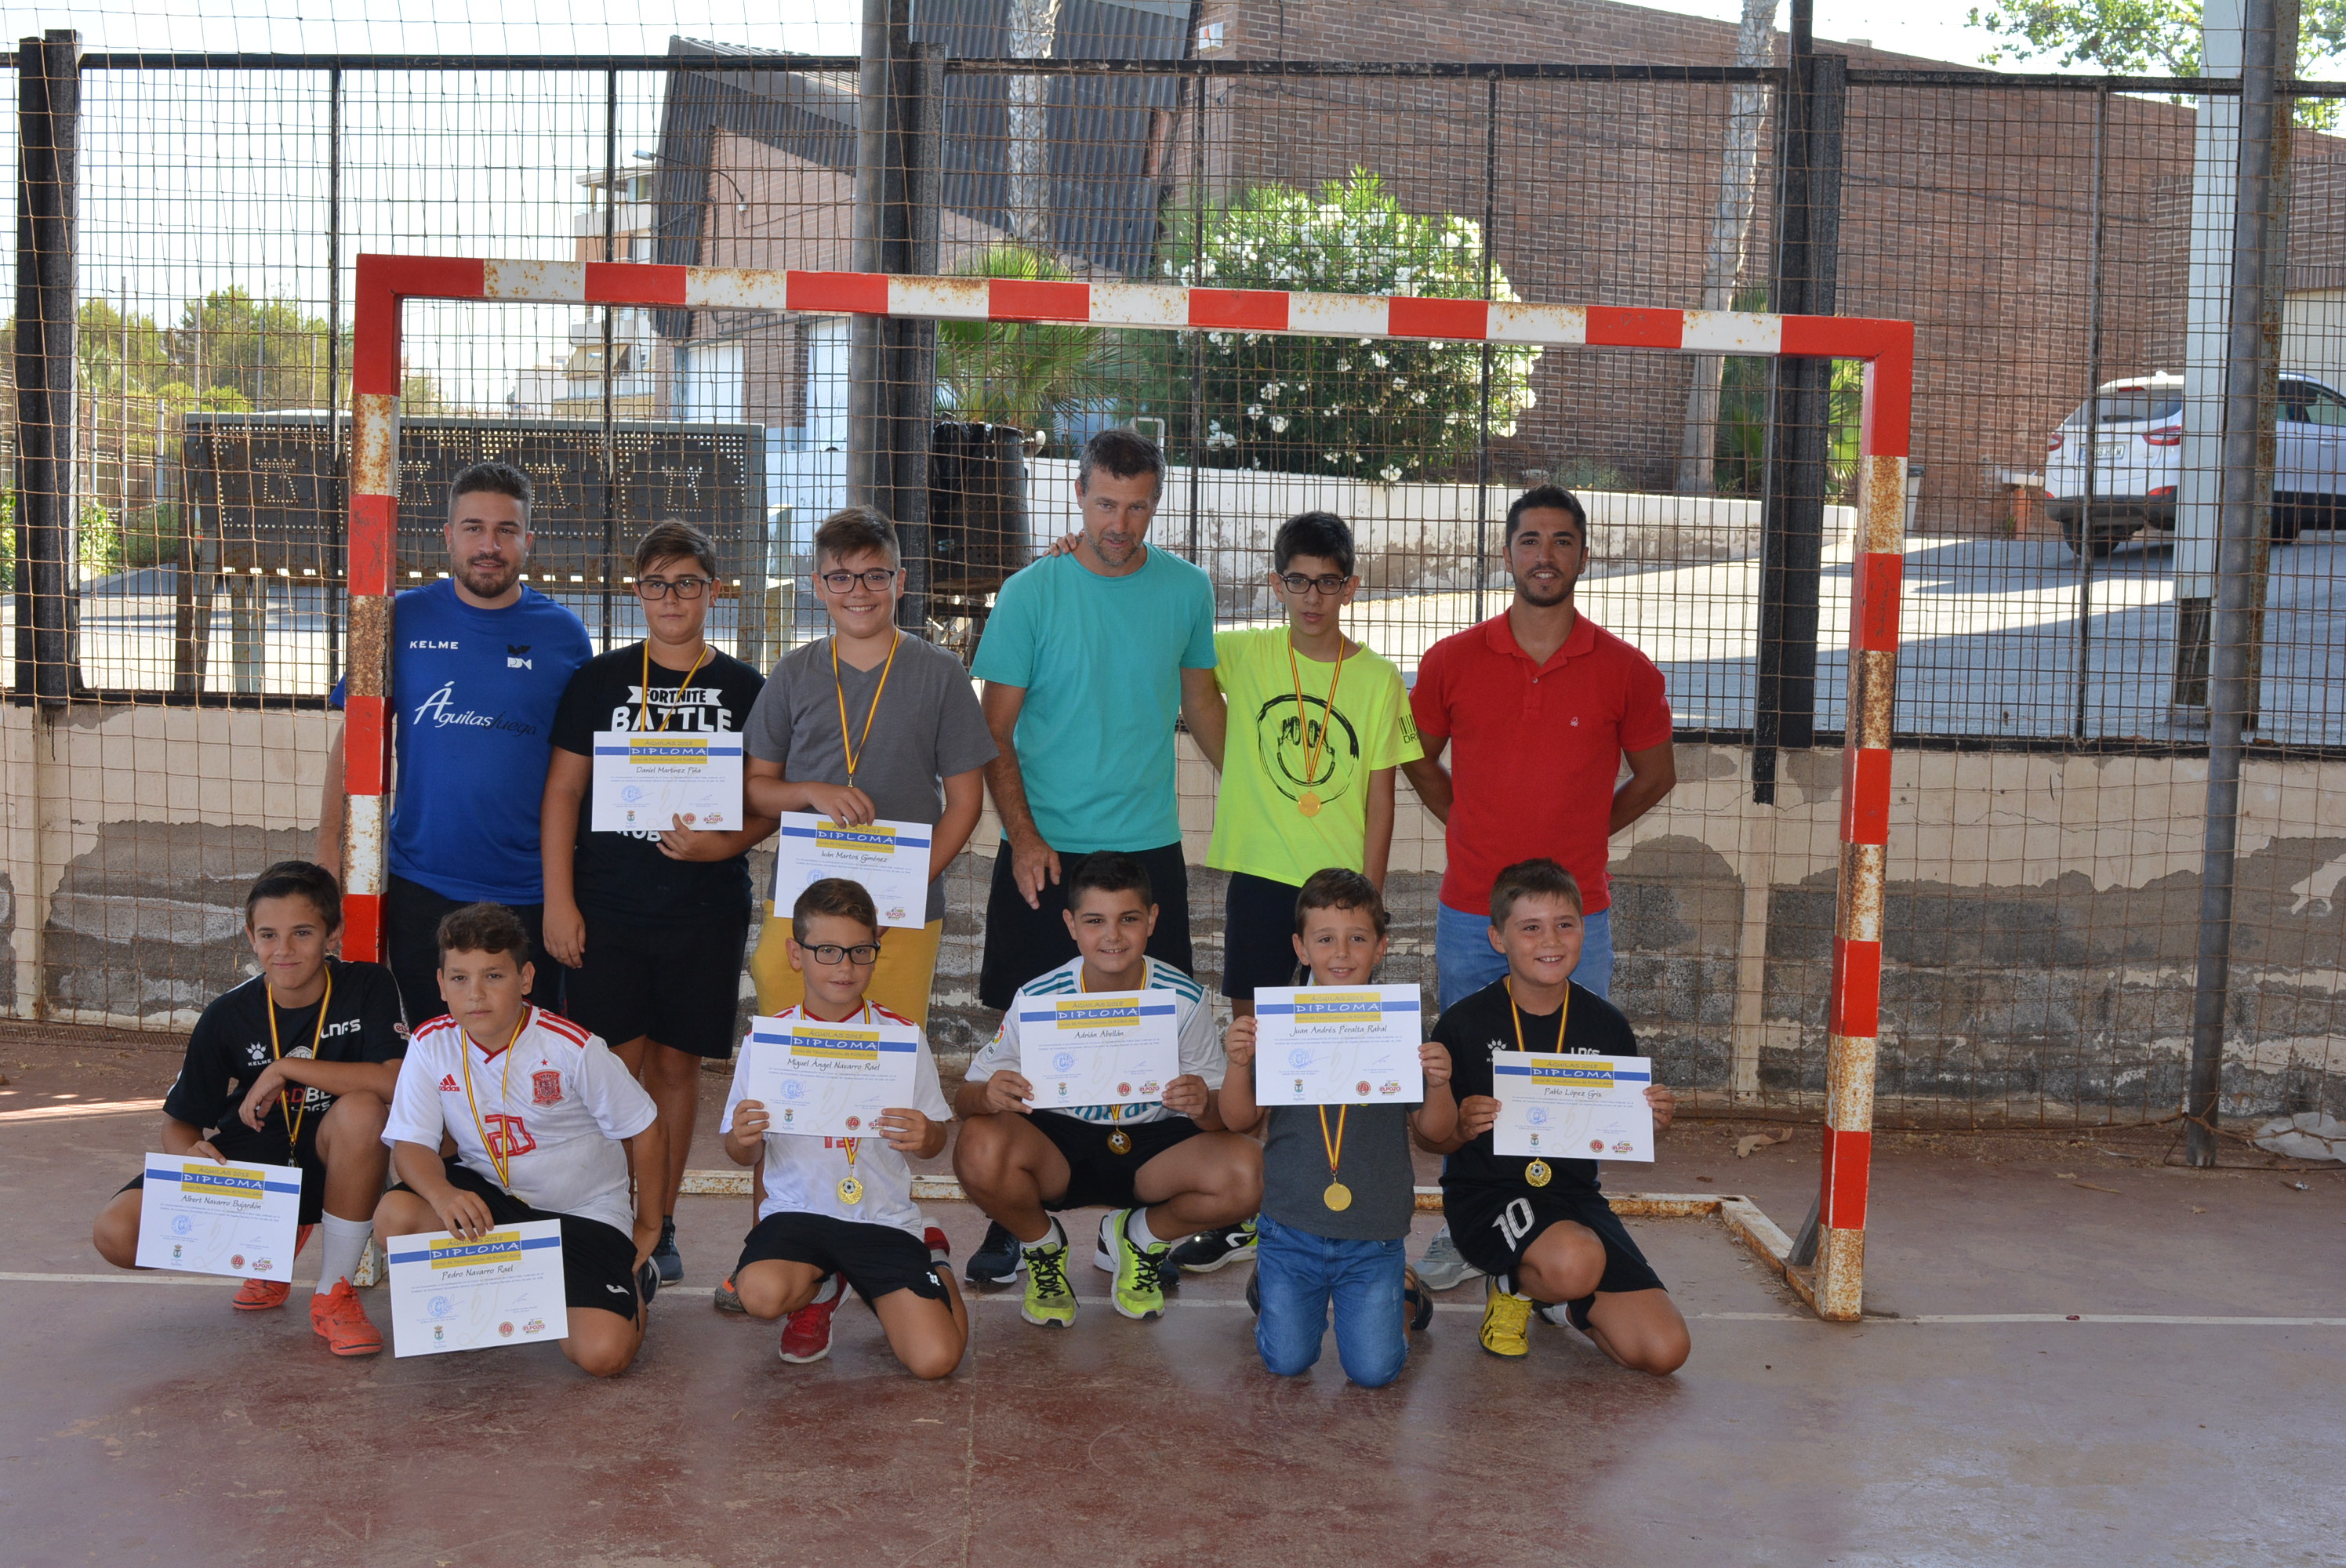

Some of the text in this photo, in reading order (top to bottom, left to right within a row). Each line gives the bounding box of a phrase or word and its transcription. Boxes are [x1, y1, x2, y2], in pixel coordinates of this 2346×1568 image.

[410, 641, 459, 649] KELME
[645, 689, 706, 703] FORTNITE
[611, 706, 732, 732] BATTLE
[817, 831, 894, 844] DIPLOMA
[860, 854, 888, 863] Giménez
[1058, 1008, 1138, 1019] DIPLOMA
[1296, 1003, 1380, 1013] DIPLOMA
[1290, 1027, 1308, 1037] Juan
[1339, 1025, 1364, 1034] Peralta
[793, 1037, 877, 1050] DIPLOMA
[787, 1058, 809, 1069] Miguel
[812, 1059, 832, 1071] Ángel
[1532, 1068, 1612, 1079] DIPLOMA
[1565, 1089, 1585, 1098] López
[1587, 1090, 1602, 1099] Gris
[484, 1114, 537, 1159] 20
[183, 1174, 263, 1189] DIPLOMA
[181, 1195, 261, 1211] Albert Navarro Bujardón
[1492, 1198, 1535, 1252] 10
[432, 1242, 519, 1259] DIPLOMA
[442, 1271, 463, 1281] Pedro
[497, 1265, 513, 1273] Rael
